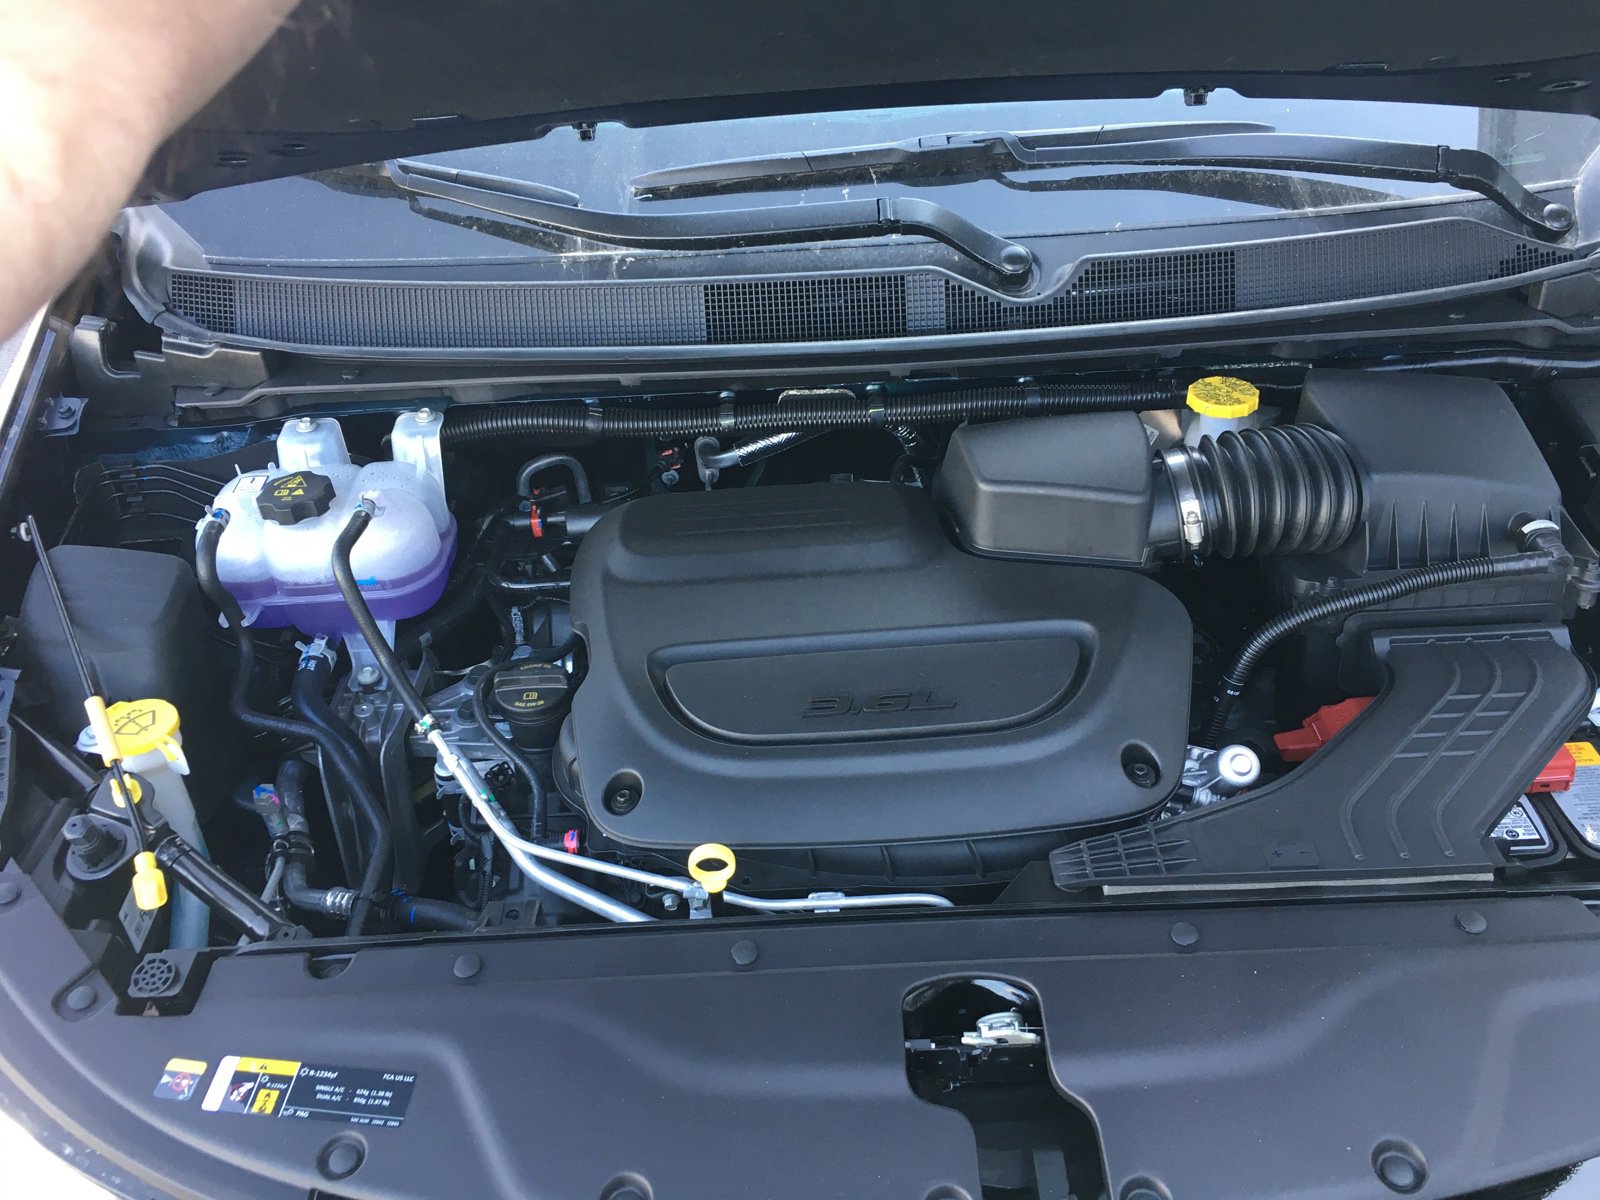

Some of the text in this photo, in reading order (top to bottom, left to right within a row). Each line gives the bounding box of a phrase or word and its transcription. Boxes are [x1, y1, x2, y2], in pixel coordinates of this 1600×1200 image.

[309, 1069, 338, 1080] R-1234yf
[383, 1073, 395, 1081] FCA
[315, 1084, 334, 1093] SINGLE
[316, 1093, 331, 1101] DUAL
[331, 1094, 342, 1102] A/C
[295, 1110, 310, 1118] PAG
